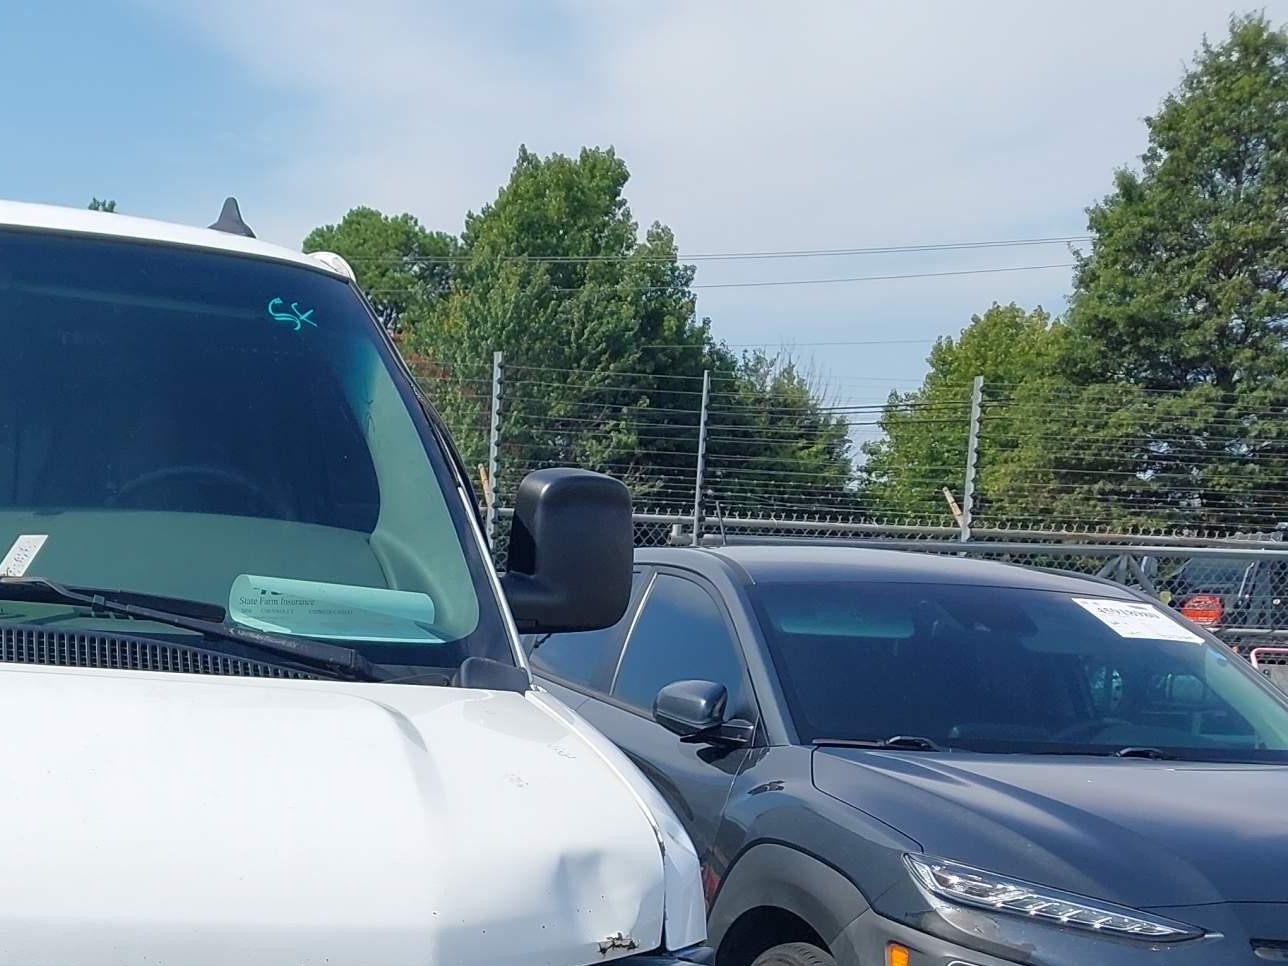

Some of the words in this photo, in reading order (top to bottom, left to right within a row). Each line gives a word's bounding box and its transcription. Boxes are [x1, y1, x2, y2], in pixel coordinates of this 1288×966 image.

[239, 597, 258, 606] State
[260, 597, 279, 606] Farm
[280, 598, 316, 607] Insurance
